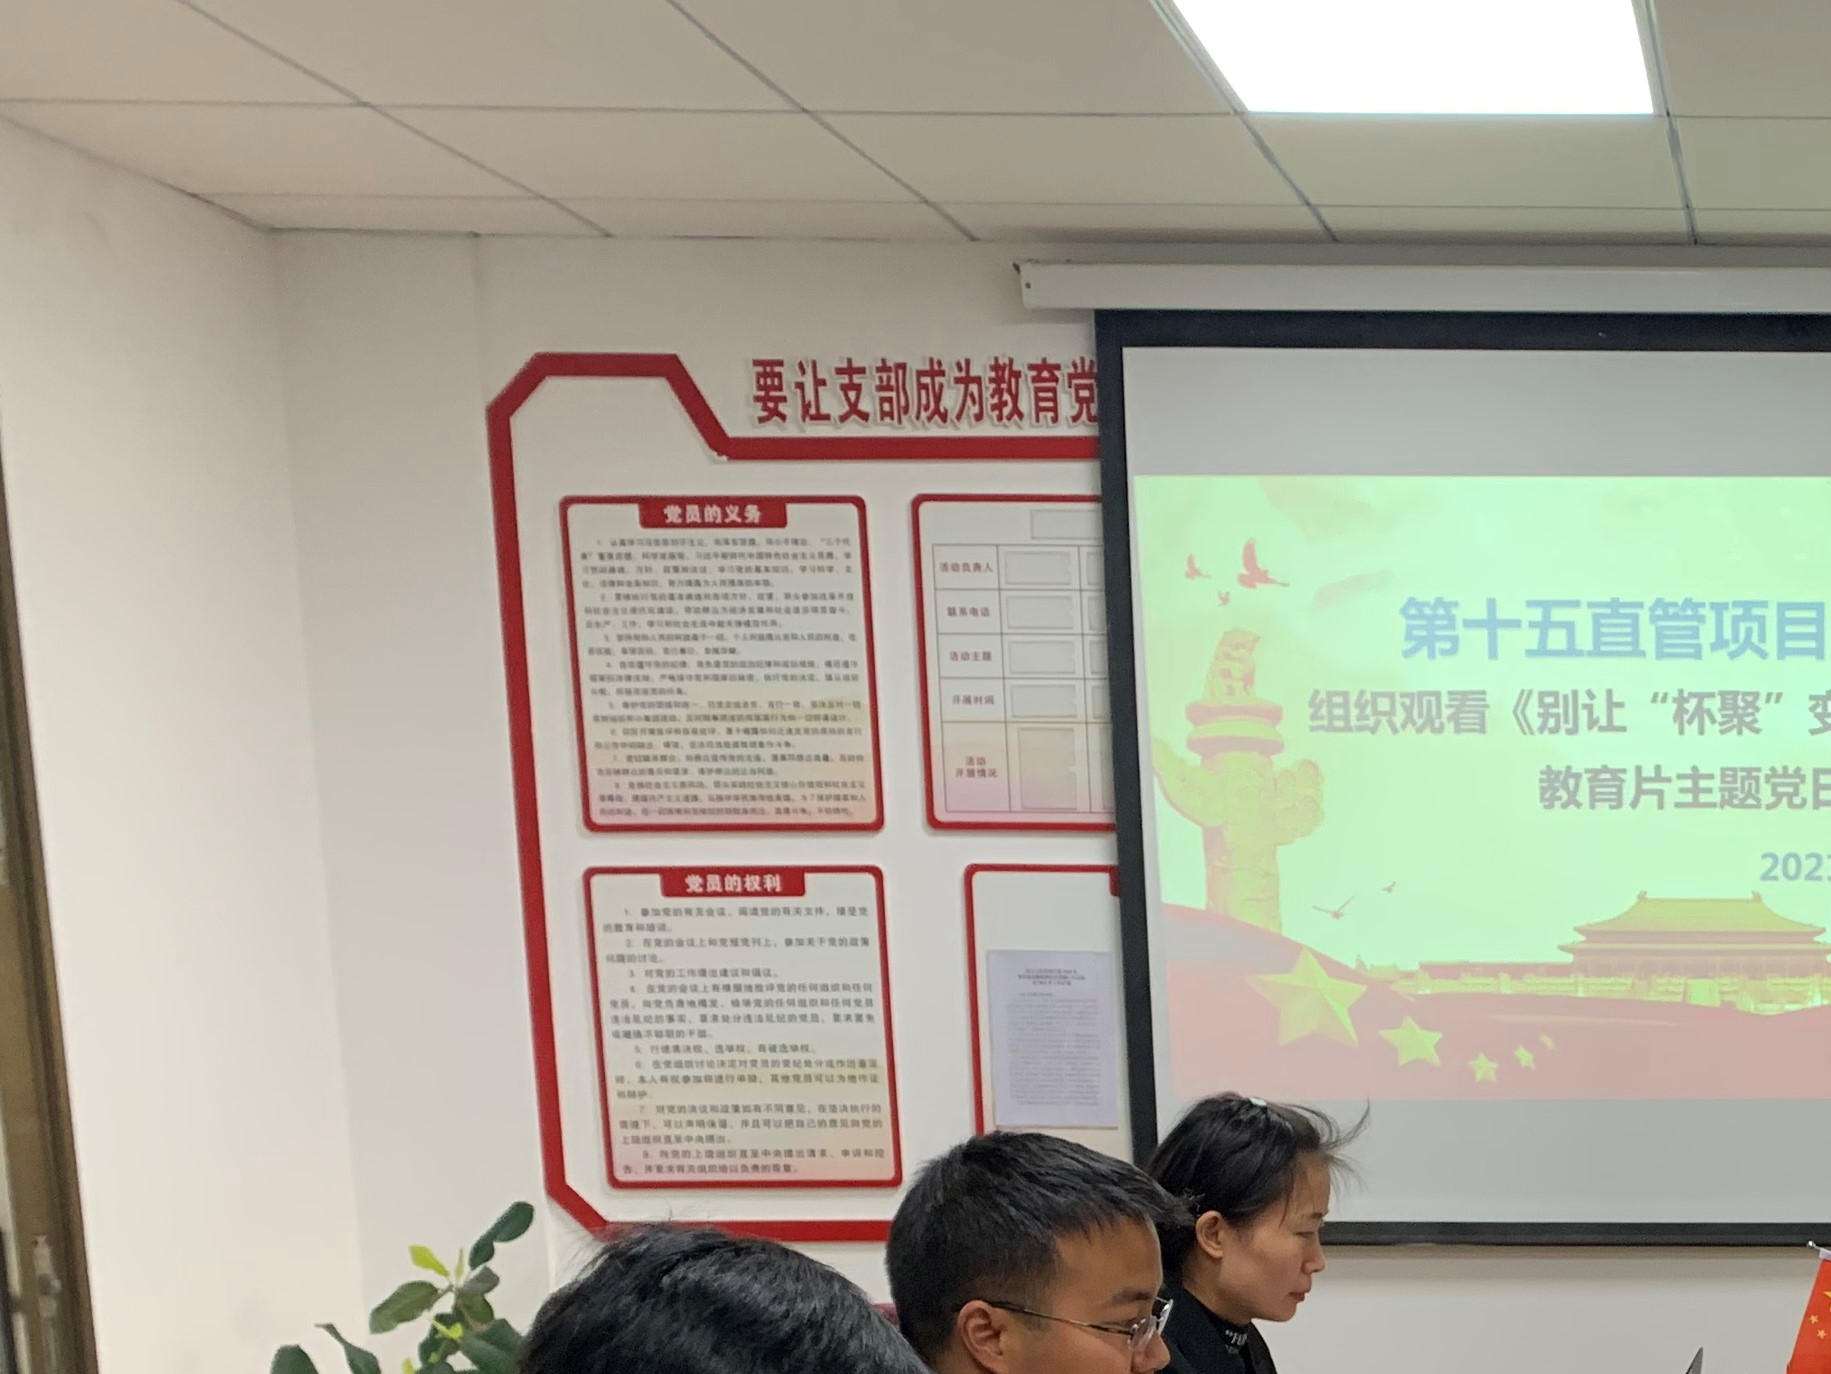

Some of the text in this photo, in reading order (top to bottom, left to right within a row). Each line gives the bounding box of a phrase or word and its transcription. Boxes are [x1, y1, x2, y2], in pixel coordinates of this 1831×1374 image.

[752, 356, 1098, 424] 要让支部成为教育党
[664, 504, 761, 523] 党员的义务
[685, 874, 782, 893] 党员的权利
